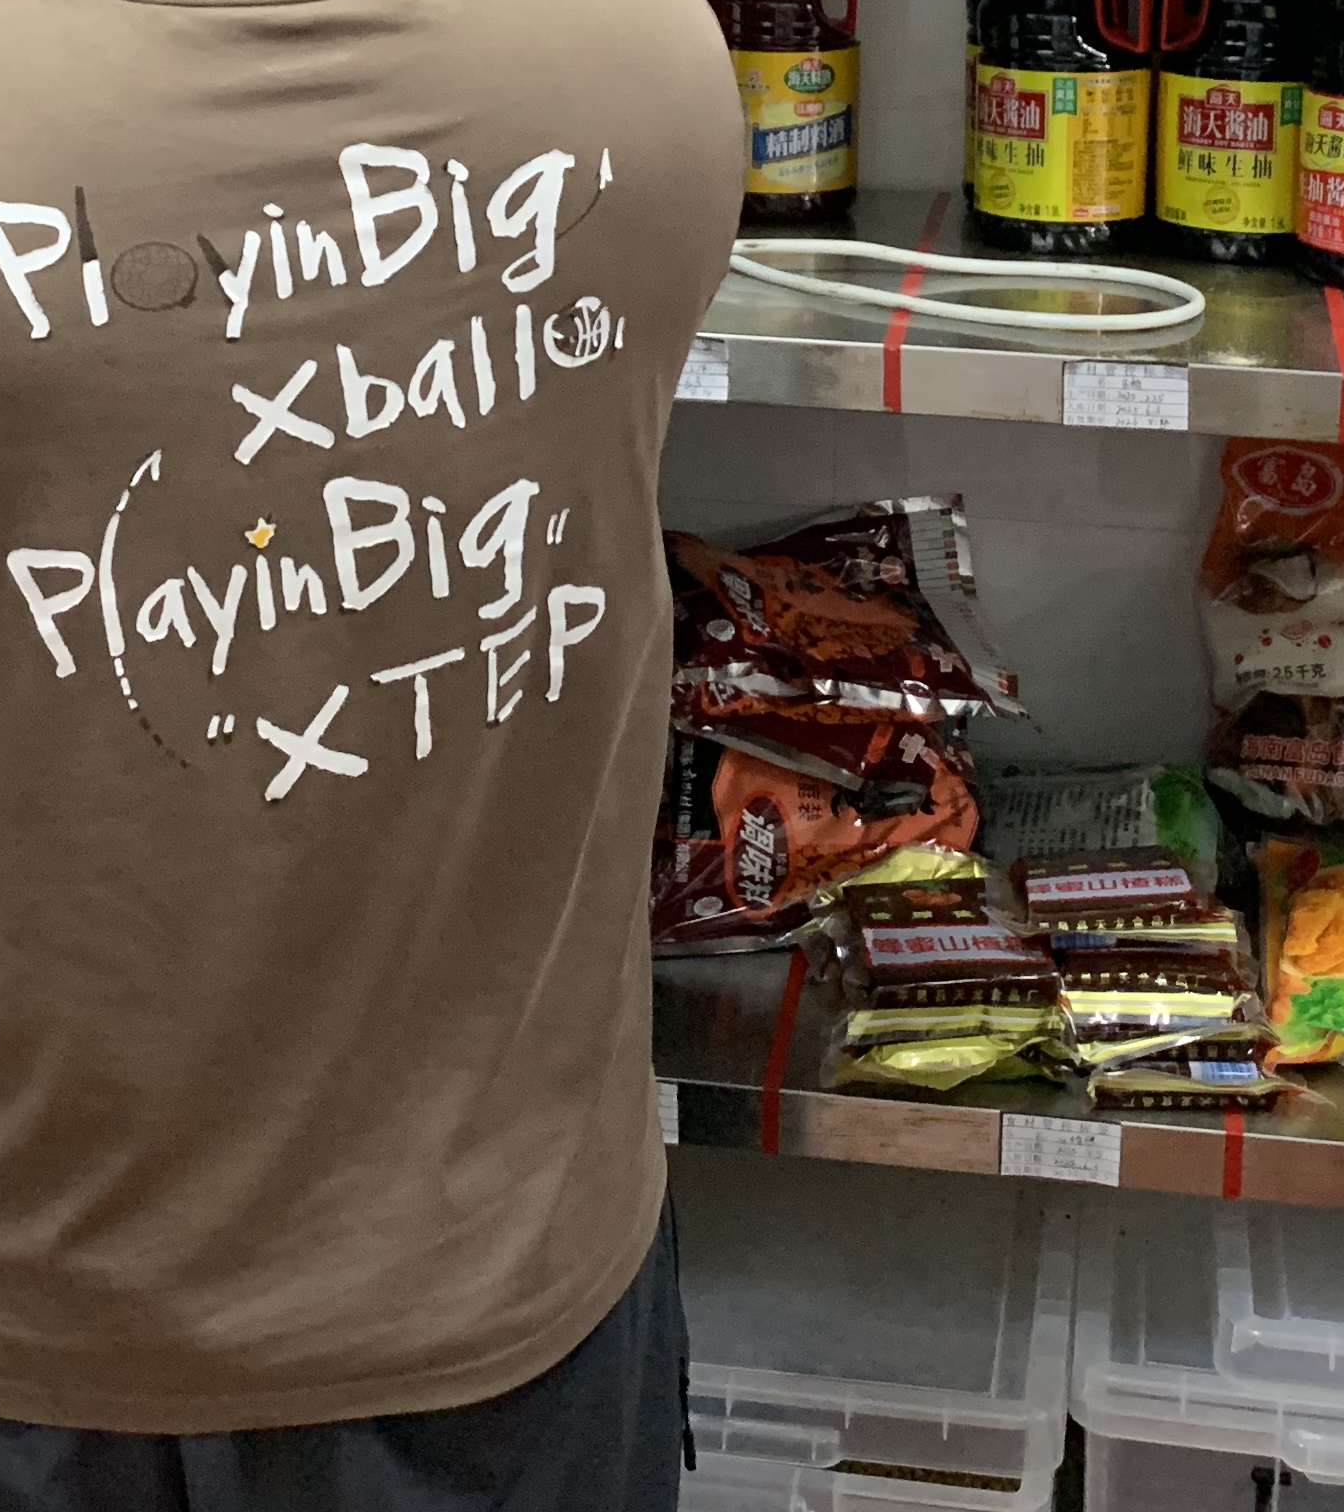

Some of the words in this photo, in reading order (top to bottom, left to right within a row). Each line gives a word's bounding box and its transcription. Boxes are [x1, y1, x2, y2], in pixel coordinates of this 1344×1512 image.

[765, 115, 844, 159] 精制料酒
[1183, 105, 1269, 141] 海天酱油
[1178, 148, 1273, 179] 鲜味生抽
[738, 807, 777, 910] 调味料
